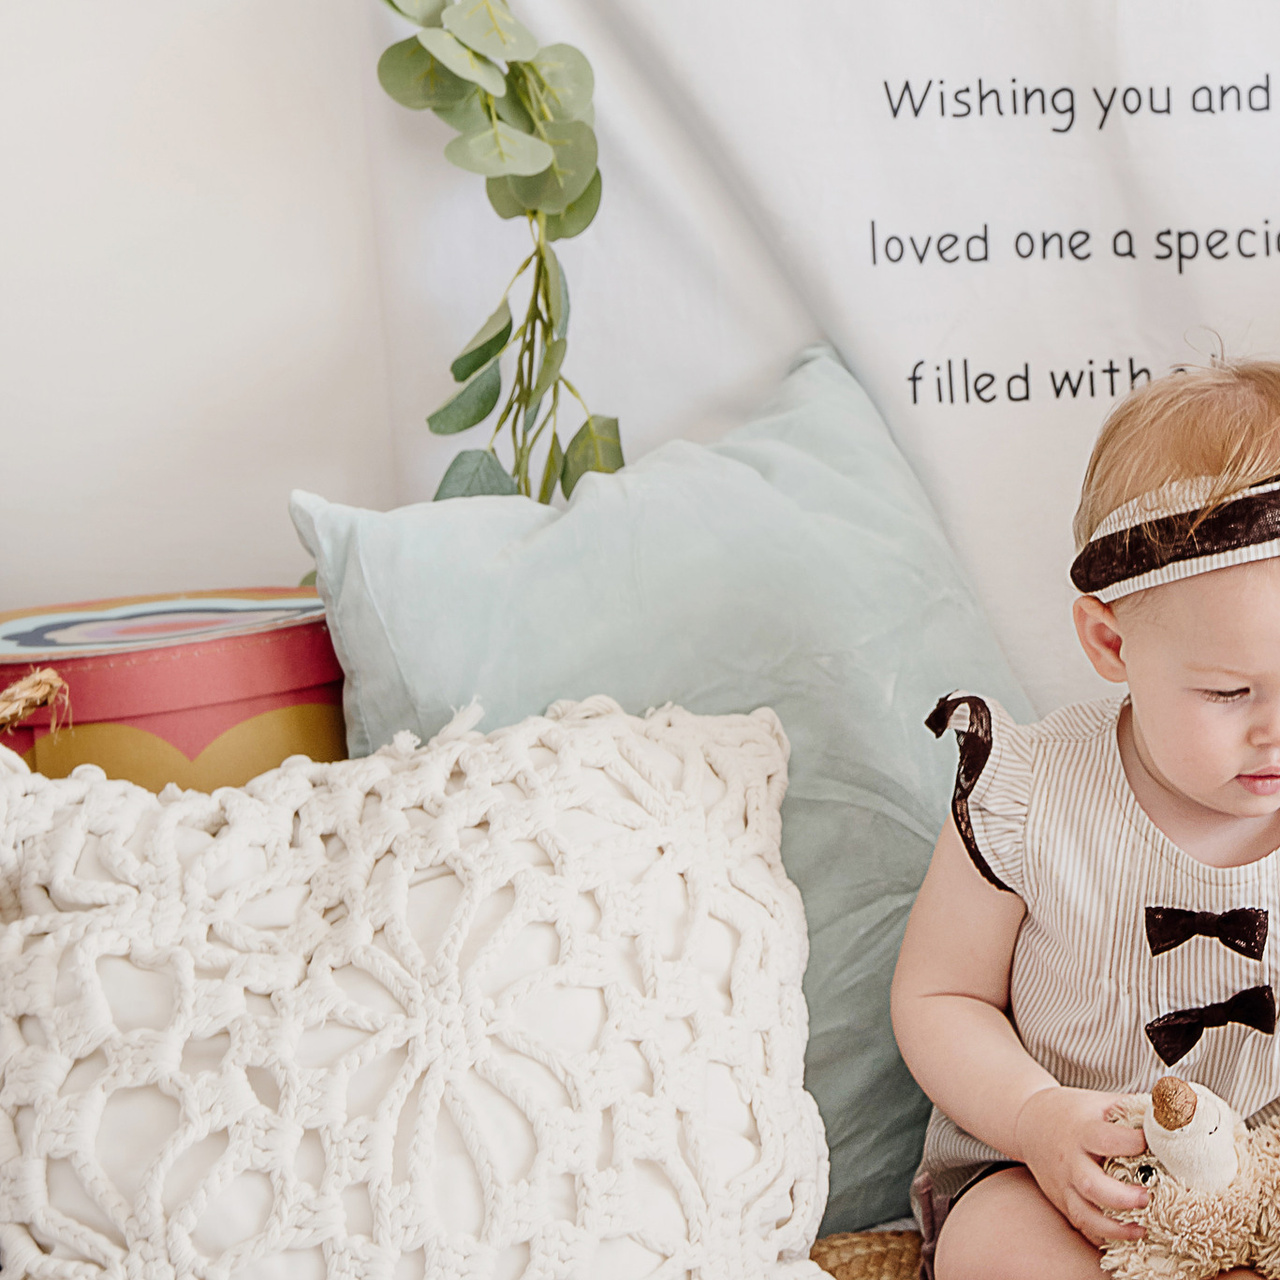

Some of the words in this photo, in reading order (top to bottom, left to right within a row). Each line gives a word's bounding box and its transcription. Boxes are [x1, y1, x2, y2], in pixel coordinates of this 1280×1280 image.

[883, 78, 1076, 133] Wishing
[1092, 86, 1171, 131] you
[1191, 73, 1270, 114] and
[870, 220, 989, 266] loved
[1014, 229, 1092, 262] one
[1112, 229, 1137, 260] a
[907, 358, 1030, 405] filled
[1049, 356, 1152, 400] with
